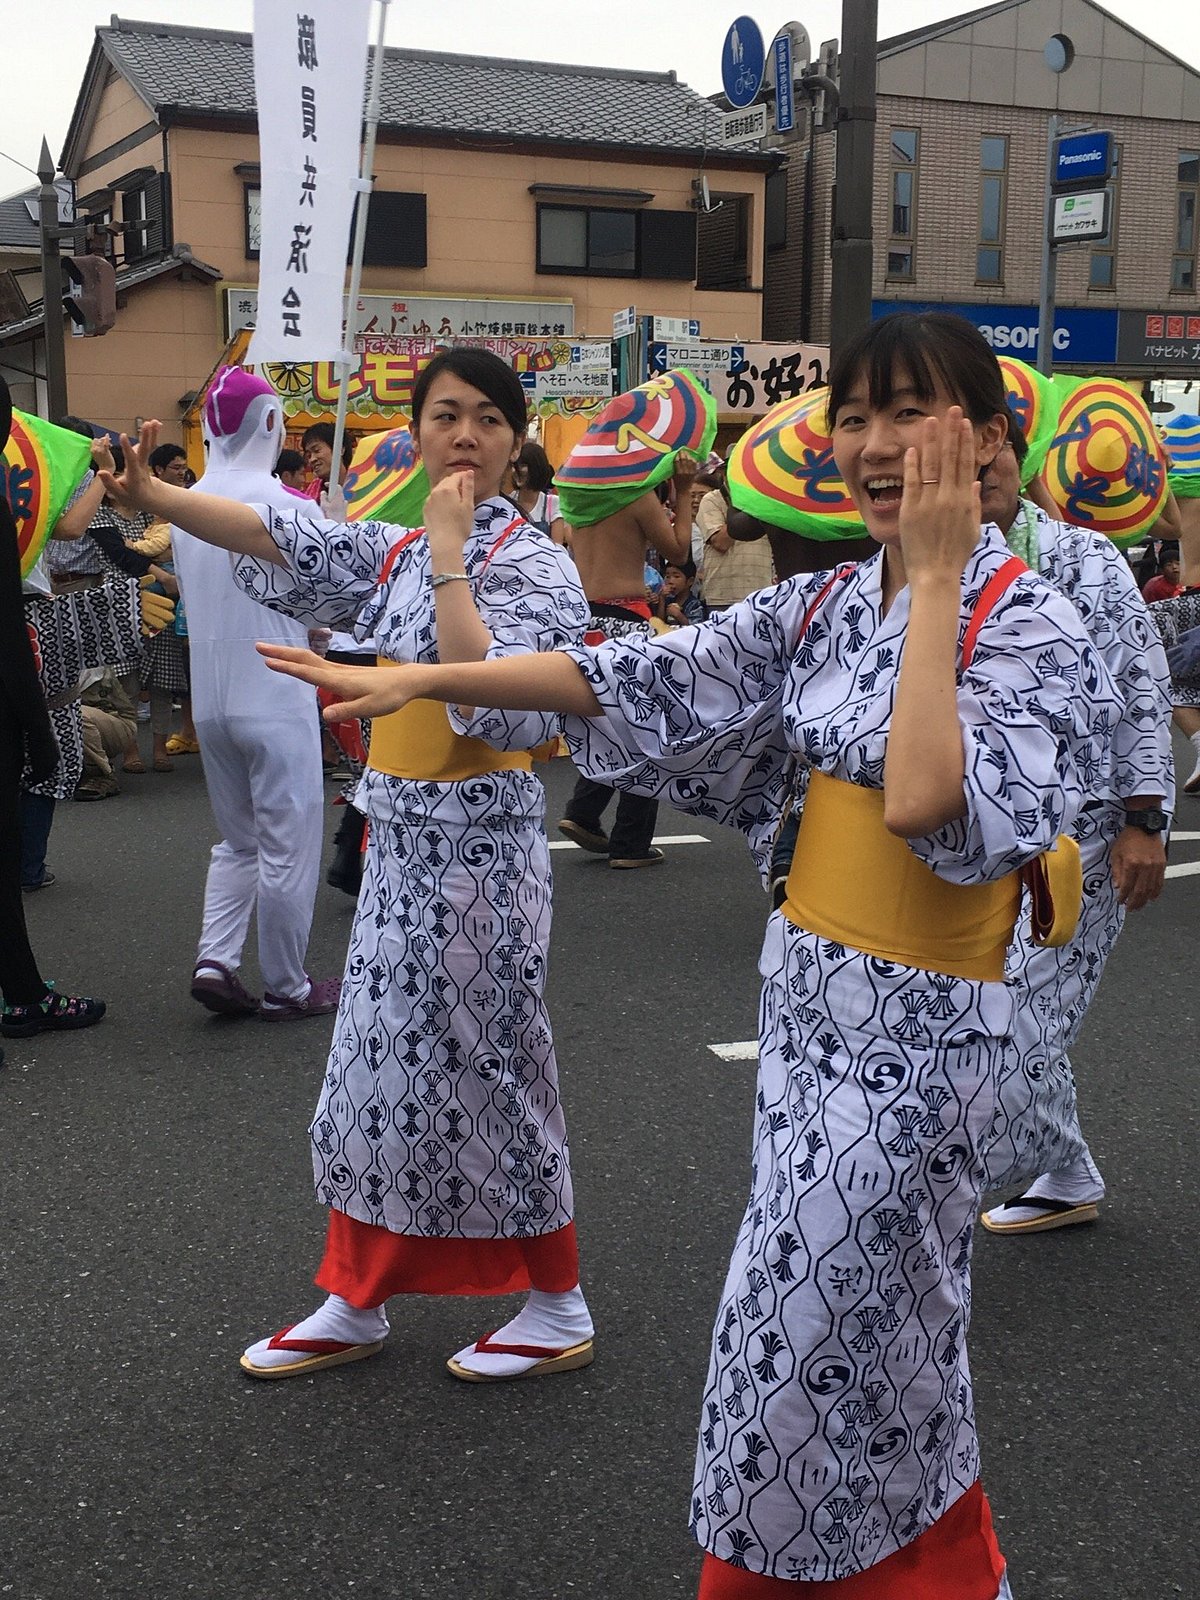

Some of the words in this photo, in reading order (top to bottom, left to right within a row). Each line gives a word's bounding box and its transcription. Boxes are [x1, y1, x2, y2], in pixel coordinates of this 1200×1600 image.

[1059, 150, 1102, 166] Panasonic
[668, 348, 730, 361] マロニエ通り
[540, 373, 610, 387] へそ石・へそ地蔵
